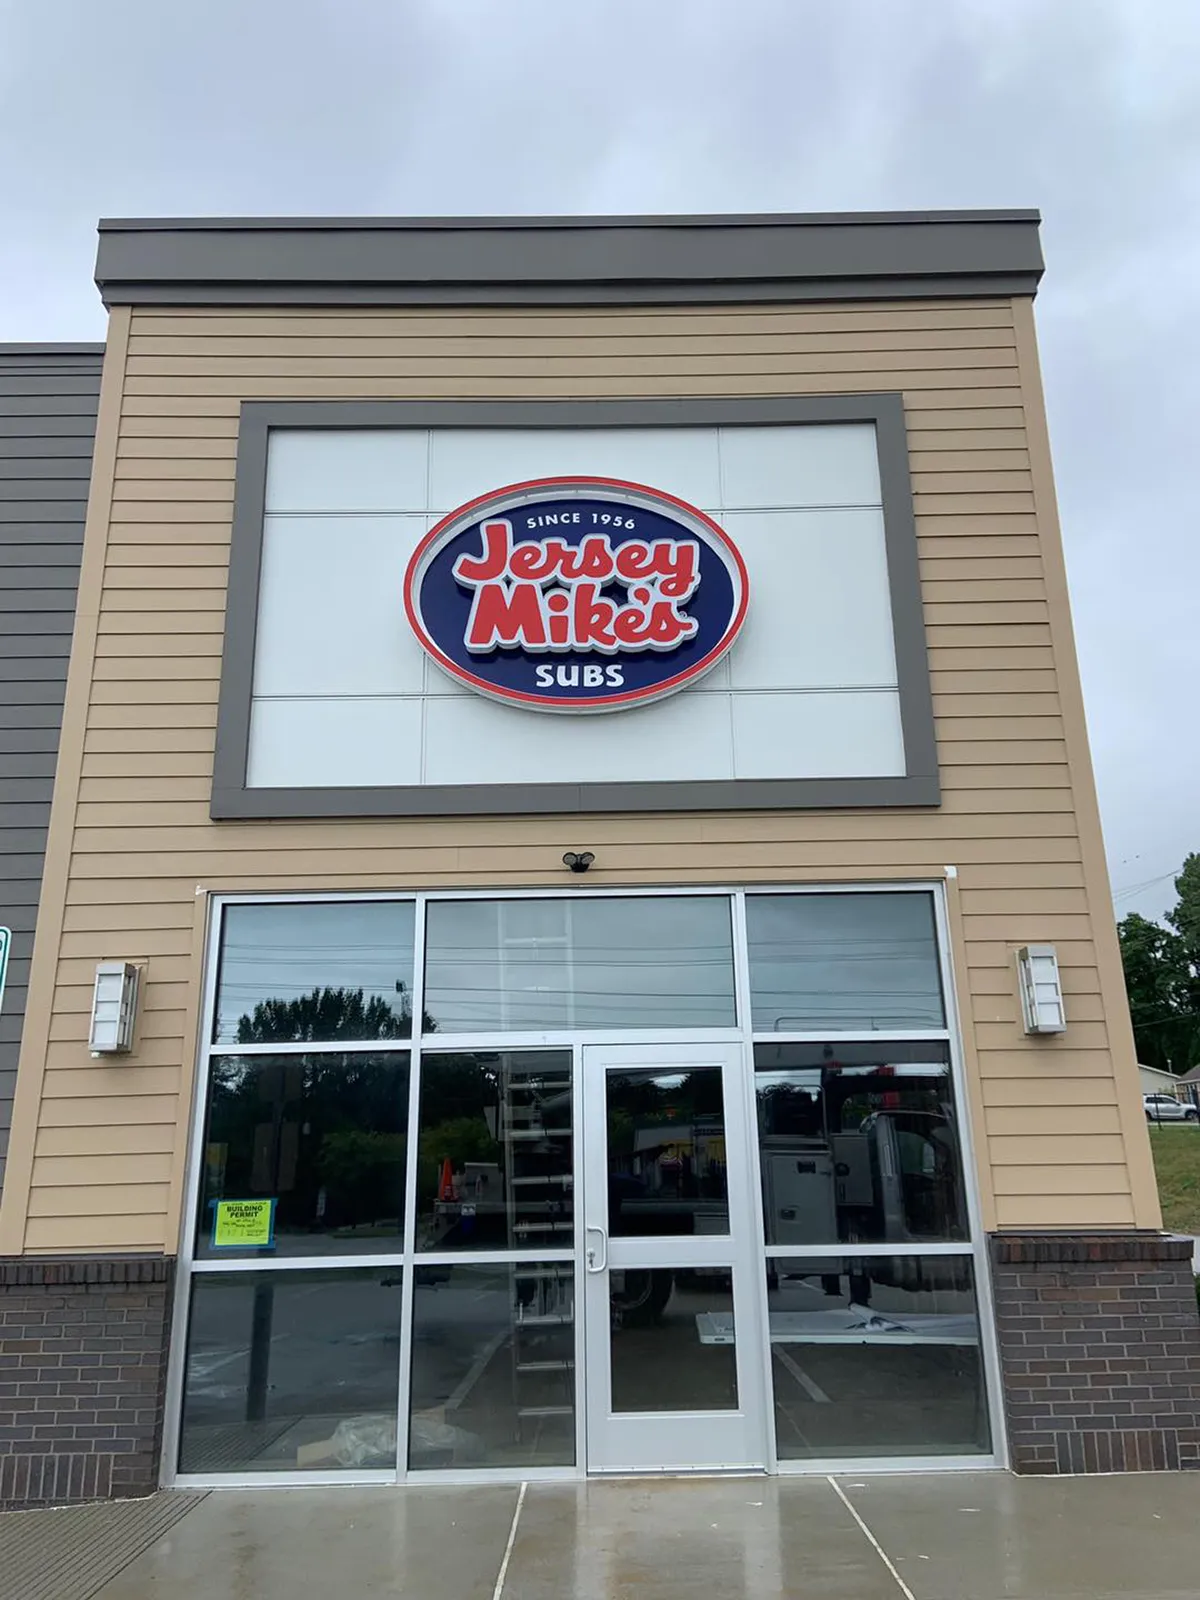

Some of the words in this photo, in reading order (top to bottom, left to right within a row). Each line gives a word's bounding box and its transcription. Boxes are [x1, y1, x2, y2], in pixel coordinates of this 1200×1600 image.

[526, 513, 581, 529] SINCE
[591, 513, 636, 530] 1956
[455, 521, 697, 599] Jersey
[467, 583, 695, 648] Mike's
[535, 664, 625, 688] SUBS
